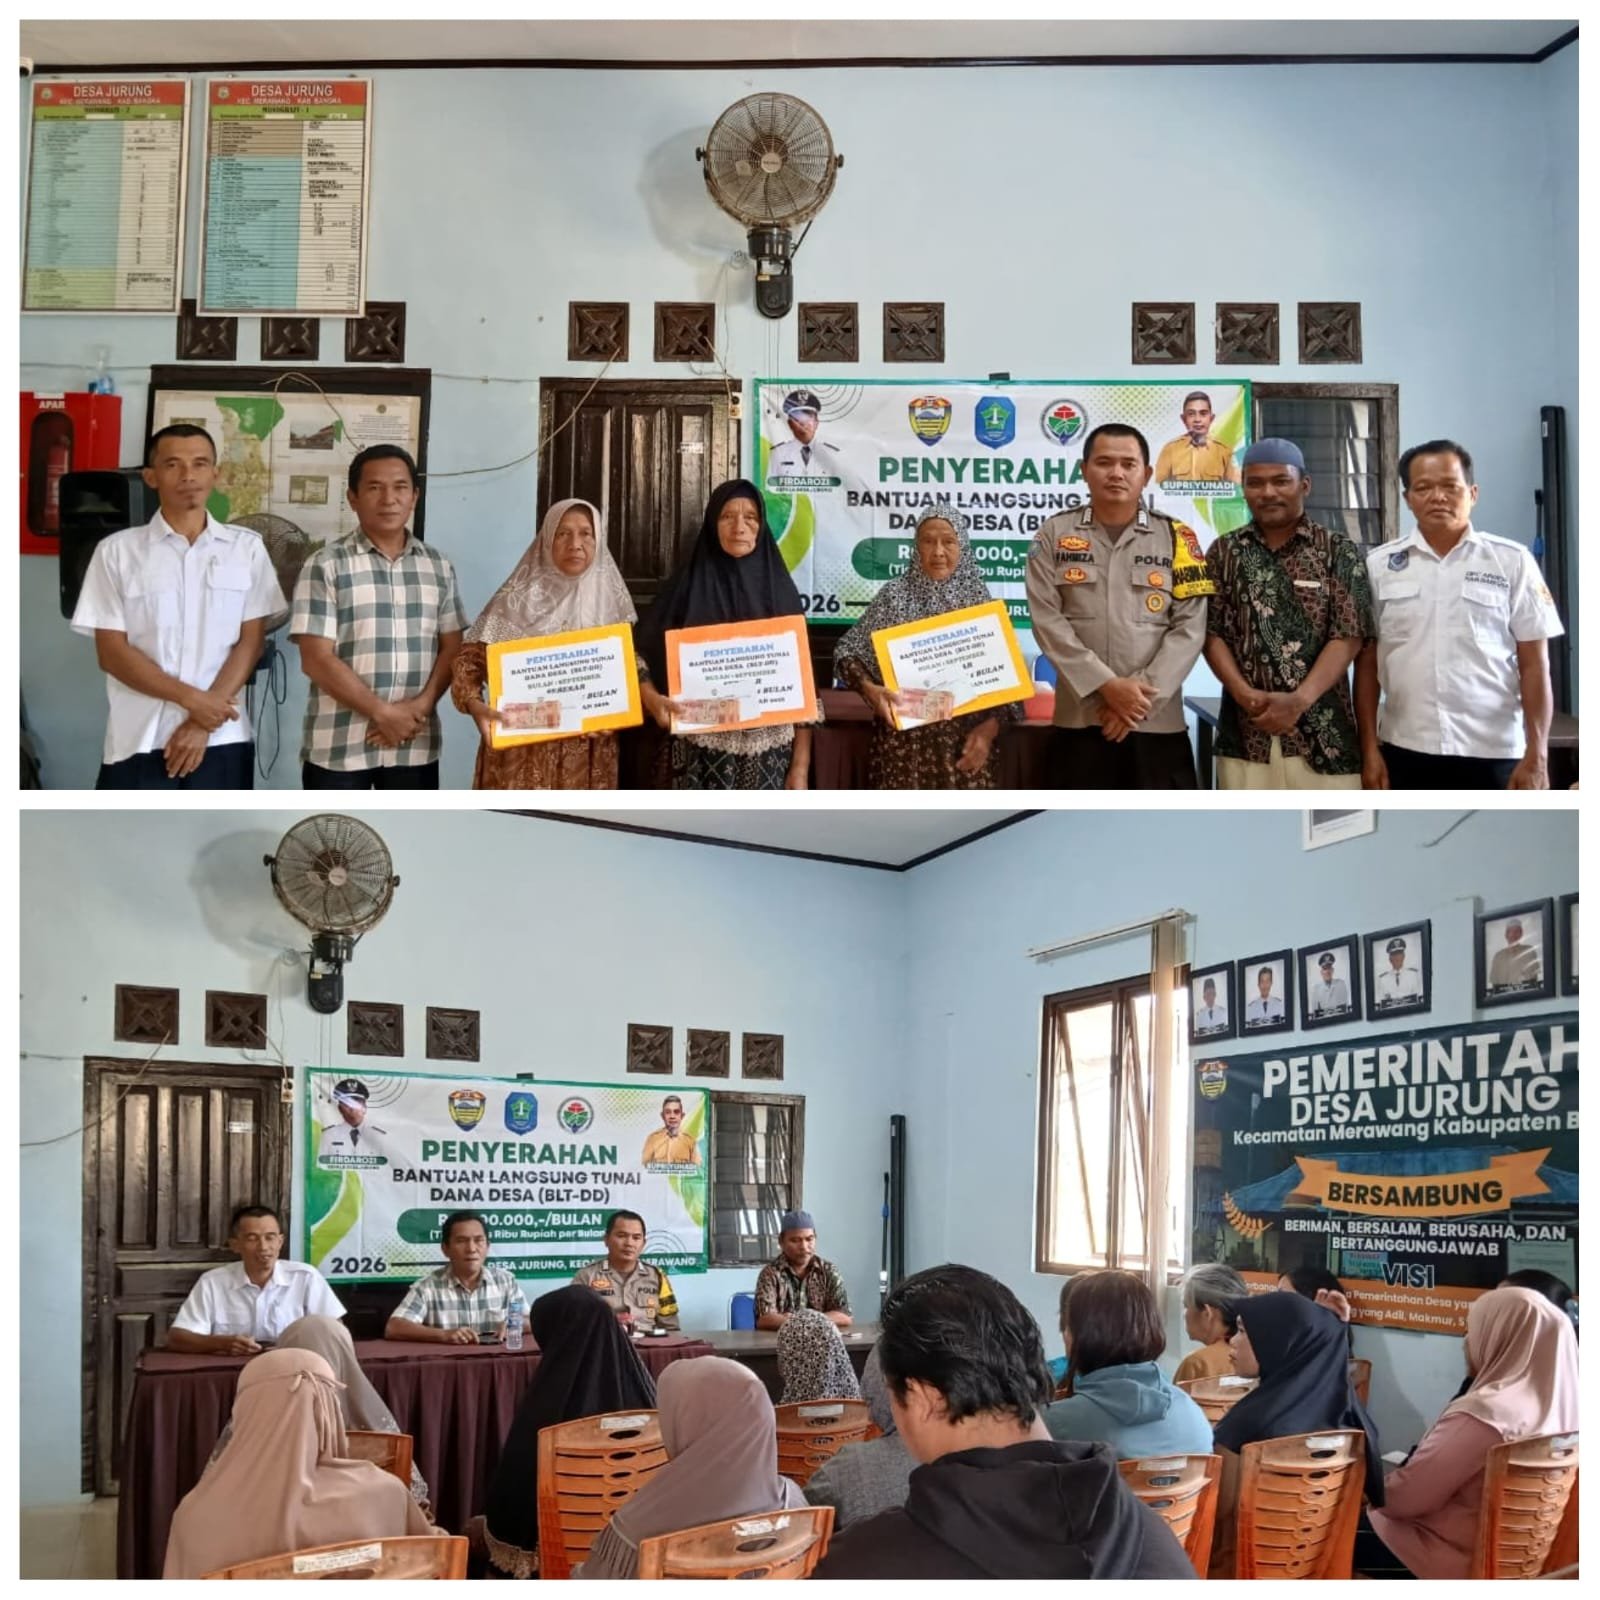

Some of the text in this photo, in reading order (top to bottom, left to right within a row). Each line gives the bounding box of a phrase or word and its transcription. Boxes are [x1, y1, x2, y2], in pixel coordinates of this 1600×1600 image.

[73, 85, 152, 97] DESA JURUNG
[251, 85, 333, 97] DESA JURUNG
[39, 400, 66, 409] APAR
[878, 457, 1086, 485] PENYERAHA
[779, 477, 829, 486] FIRDAROZI
[1163, 481, 1234, 490] SUPRIYUNADI
[847, 490, 951, 508] BANTUAN
[957, 492, 1081, 509] LANGSUNG
[996, 566, 1025, 579] Rupi
[799, 594, 840, 613] 026
[911, 625, 978, 649] PENYERAHAN
[526, 647, 599, 665] PENYERAHAN
[703, 642, 774, 658] PENYERAHAN
[1290, 1089, 1377, 1127] DESA
[1386, 1075, 1560, 1121] JURUNG
[1233, 1122, 1327, 1146] Kecamatan
[1329, 1120, 1429, 1142] Merawang
[1434, 1112, 1561, 1138] Kabupaten
[422, 1140, 618, 1165] PENYERAHAN
[393, 1168, 641, 1185] BANTUAN LANGSUNG TUNAI
[430, 1188, 610, 1205] DANA DESA (BLT-DD)
[1327, 1181, 1503, 1207] BERSAMBUNG
[495, 1229, 605, 1240] Ribu Rupiah per Bulan
[1284, 1219, 1566, 1241] BERIMAN, BERSALAM, BERUSAHA, DAN
[1332, 1237, 1500, 1257] BERTANGGUNGJAWAB
[331, 1258, 387, 1274] 2026
[518, 1259, 568, 1271] JURUNG,
[646, 1257, 697, 1267] ERAWANG
[1381, 1262, 1435, 1289] VISI
[1353, 1289, 1424, 1305] Pemerintahan
[1425, 1296, 1452, 1308] Desa
[1359, 1308, 1384, 1320] yang
[1385, 1308, 1407, 1321] Adil,
[1408, 1312, 1457, 1326] Makmur,
